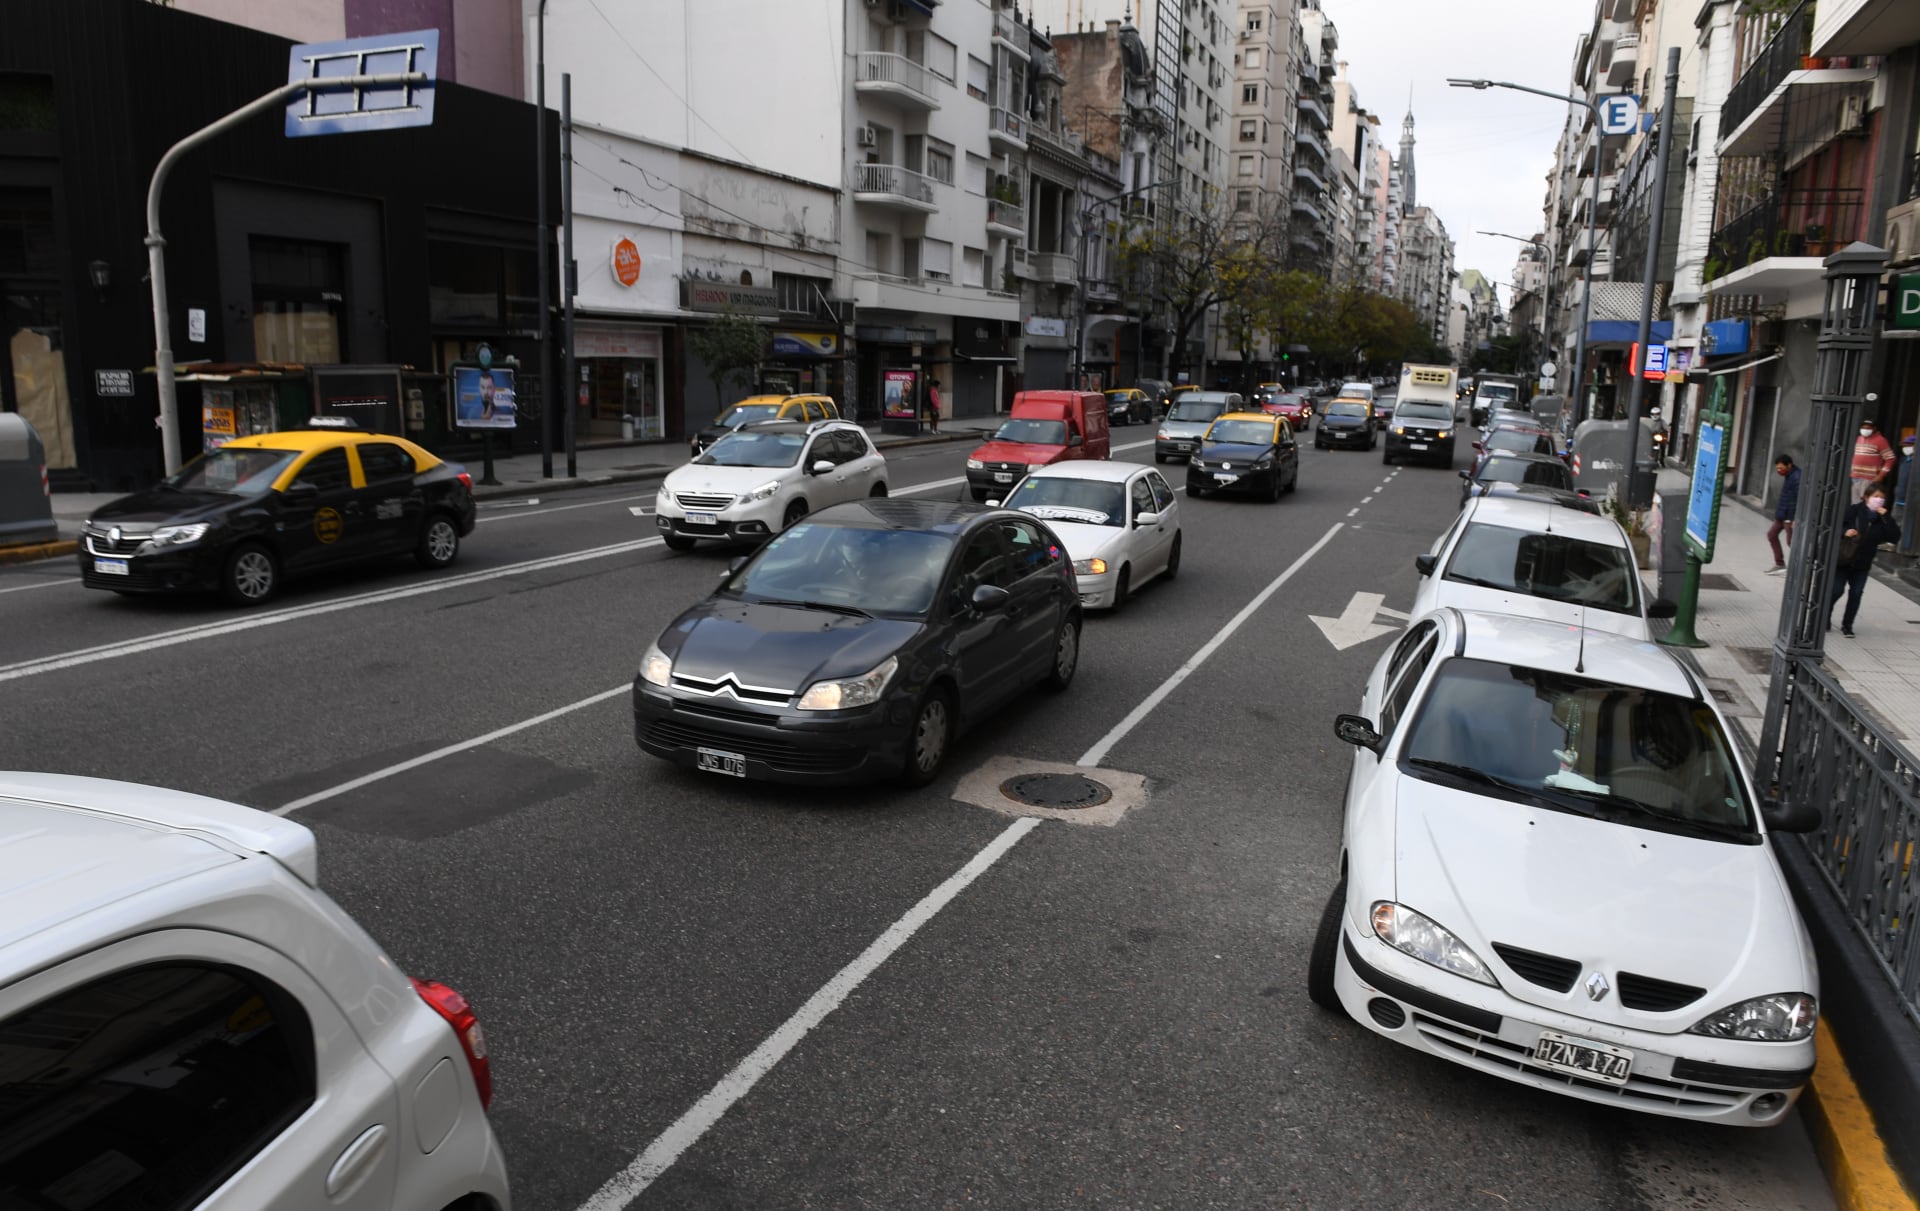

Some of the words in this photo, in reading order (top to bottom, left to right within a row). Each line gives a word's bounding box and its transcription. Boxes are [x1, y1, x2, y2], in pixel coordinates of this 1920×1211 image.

[1608, 103, 1627, 126] E
[730, 292, 742, 305] VIA
[1902, 290, 1920, 314] D
[1646, 347, 1664, 369] E
[724, 758, 744, 773] 076
[1540, 1041, 1577, 1065] HZN
[1587, 1051, 1628, 1077] 174
